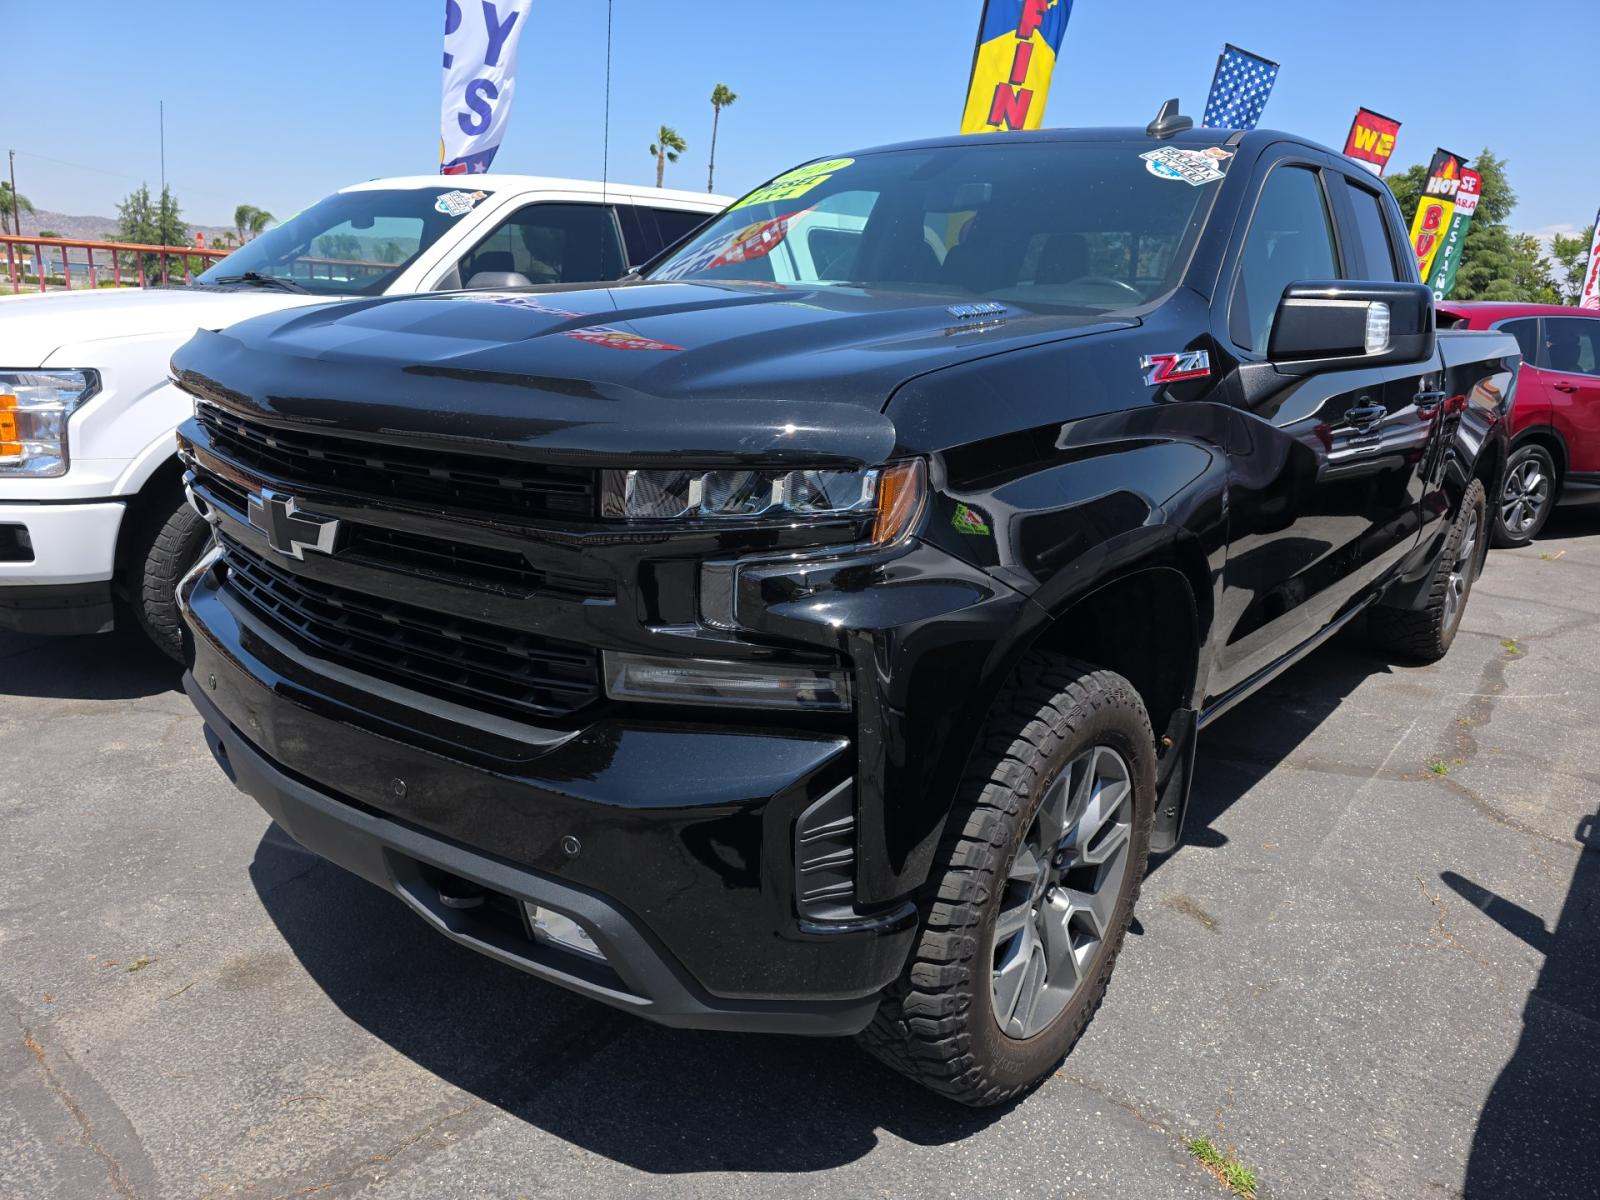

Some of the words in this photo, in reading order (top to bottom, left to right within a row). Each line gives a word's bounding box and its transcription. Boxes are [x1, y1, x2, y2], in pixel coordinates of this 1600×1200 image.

[1354, 125, 1396, 158] WE
[1425, 176, 1461, 196] HOT
[1460, 175, 1477, 192] SE
[1140, 349, 1211, 387] Z71
